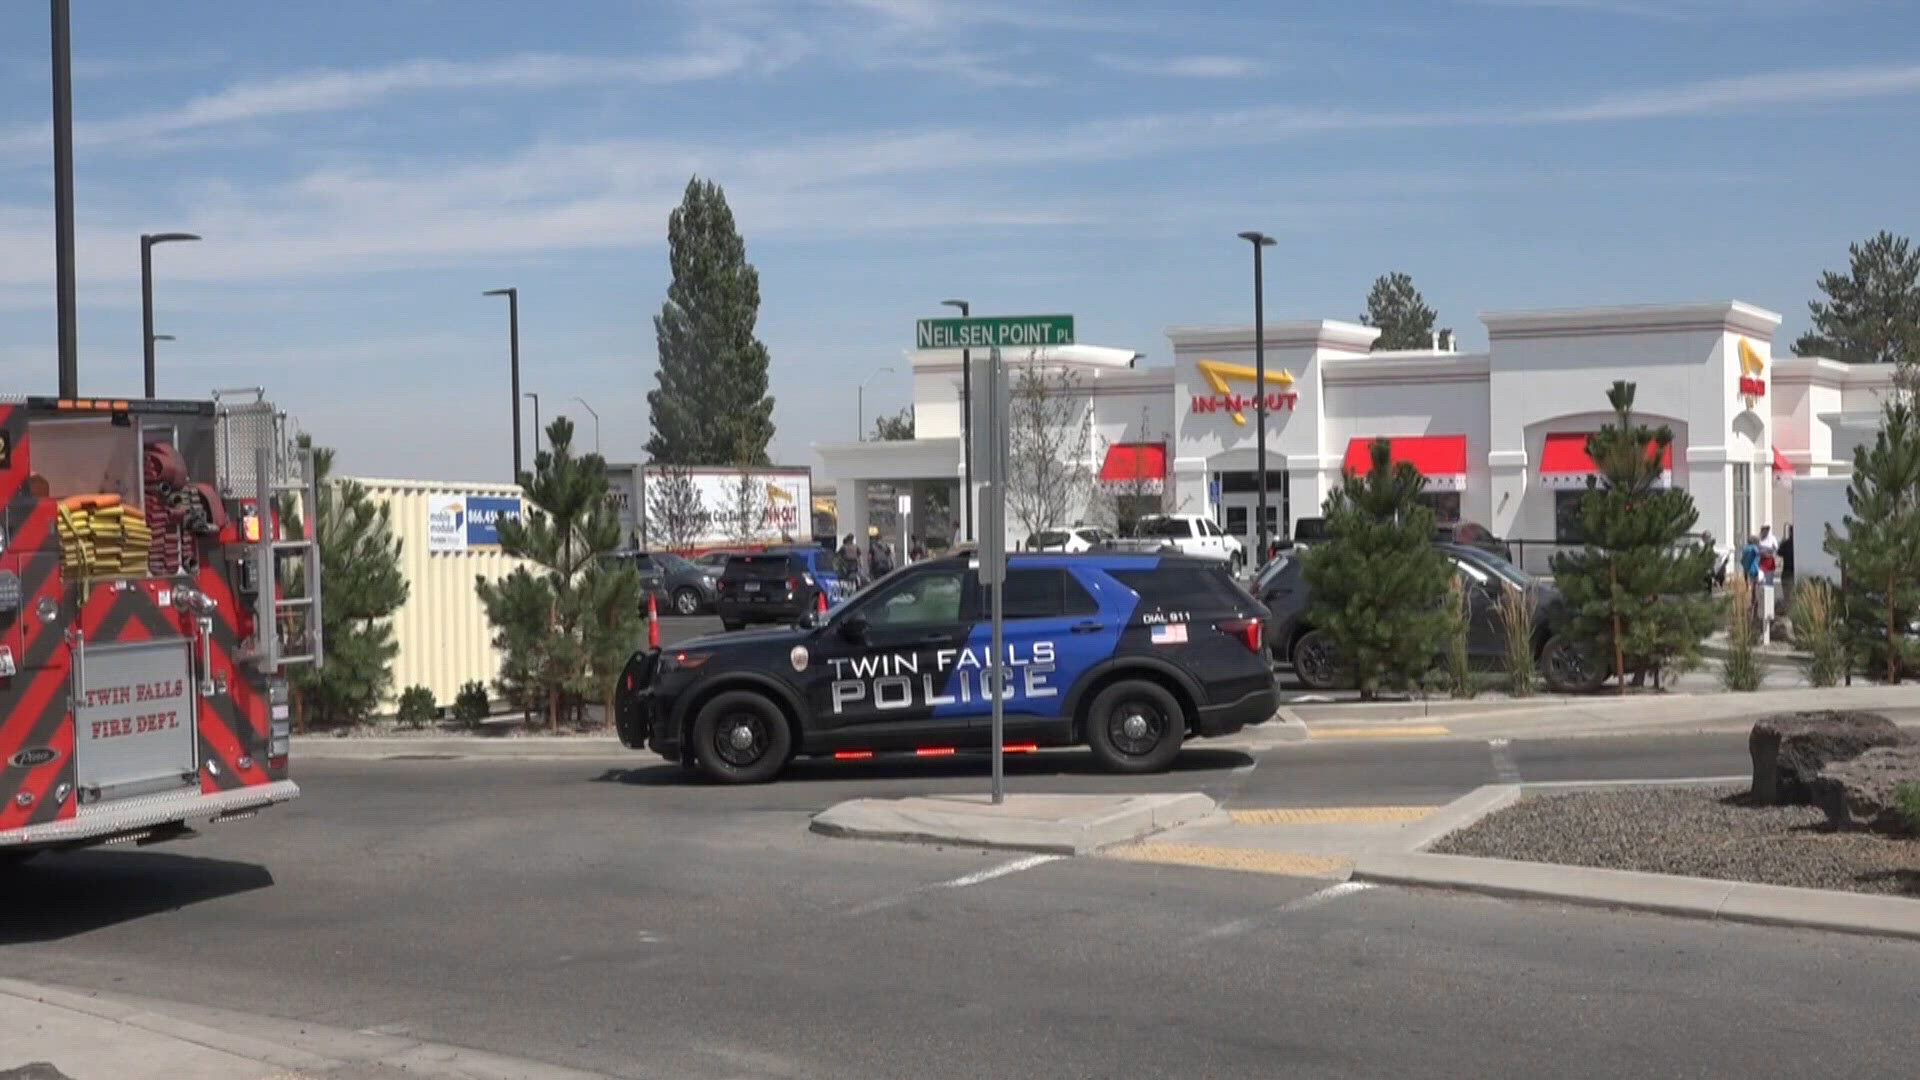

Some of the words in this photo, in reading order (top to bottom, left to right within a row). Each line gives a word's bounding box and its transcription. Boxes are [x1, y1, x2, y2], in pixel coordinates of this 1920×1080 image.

[918, 321, 993, 347] NEILSEN
[999, 323, 1053, 344] POINT
[1057, 329, 1071, 343] PL
[1192, 392, 1297, 414] IN-N-OUT
[1143, 612, 1168, 624] DIAL
[1169, 611, 1190, 622] 911
[827, 652, 918, 680] TWIN
[937, 641, 1055, 672] FALLS
[85, 686, 130, 708] TWIN
[136, 679, 183, 702] FALLS
[831, 662, 1058, 714] POLICE
[92, 718, 132, 739] FIRE
[136, 711, 179, 733] DEPT.
